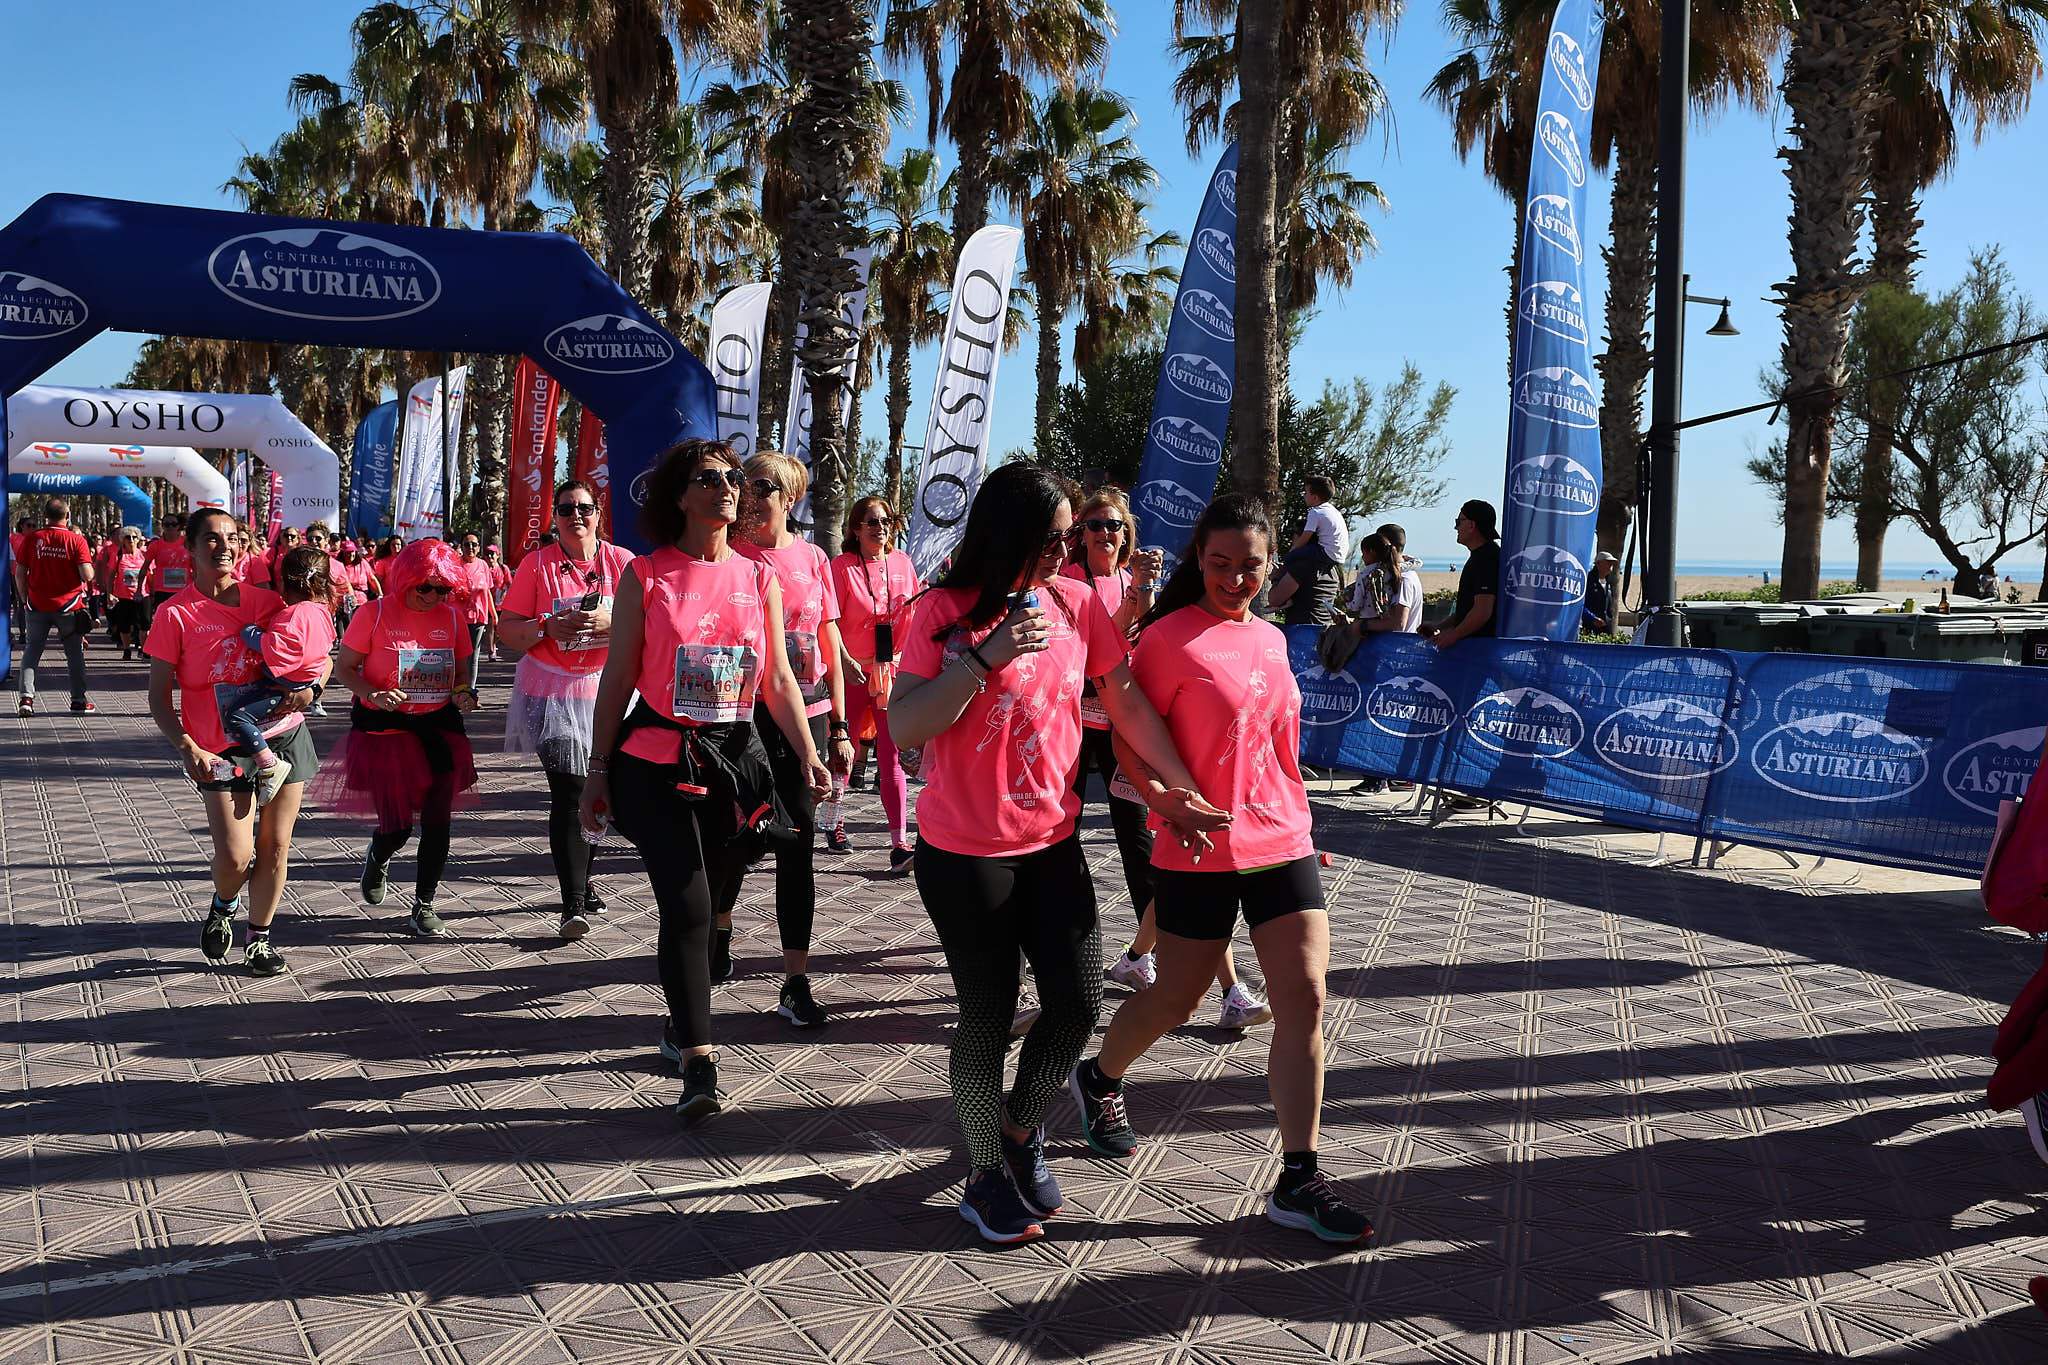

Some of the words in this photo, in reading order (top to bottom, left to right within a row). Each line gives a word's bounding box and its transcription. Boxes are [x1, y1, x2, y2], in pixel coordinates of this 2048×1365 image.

[263, 250, 337, 266] CENTRAL
[345, 257, 417, 272] LECHERA
[1199, 234, 1236, 277] ASTURIAN
[226, 249, 425, 302] ASTURIANA
[0, 303, 76, 326] RIANA
[21, 295, 74, 307] LECHERA
[555, 336, 668, 359] ASTURIANA
[716, 333, 753, 455] SHO
[1168, 360, 1230, 401] ASTURIANA
[64, 398, 225, 433] OYSHO
[922, 269, 1002, 529] OYSHO
[1518, 381, 1597, 421] ASTURIANA
[528, 371, 549, 466] Santander
[268, 438, 313, 448] OYSHO
[1155, 424, 1217, 461] ASTURIANA
[27, 473, 82, 490] Marlene
[363, 443, 391, 505] Marlene
[1512, 473, 1594, 507] ASTURIANA
[292, 497, 333, 507] OYSHO
[523, 494, 542, 551] Sports
[664, 591, 701, 601] OYSHO
[1202, 650, 1241, 662] OYSHO
[2036, 646, 2048, 657] Ey
[1300, 691, 1353, 712] STURIANA
[1371, 692, 1448, 726] ASTURIANA
[1491, 709, 1529, 720] CENTRAL
[1471, 709, 1573, 747] ASTURIANA
[1600, 722, 1724, 765] ASTURIANA
[1761, 739, 1912, 786] ASTURIANA
[1992, 755, 2040, 768] CENTR
